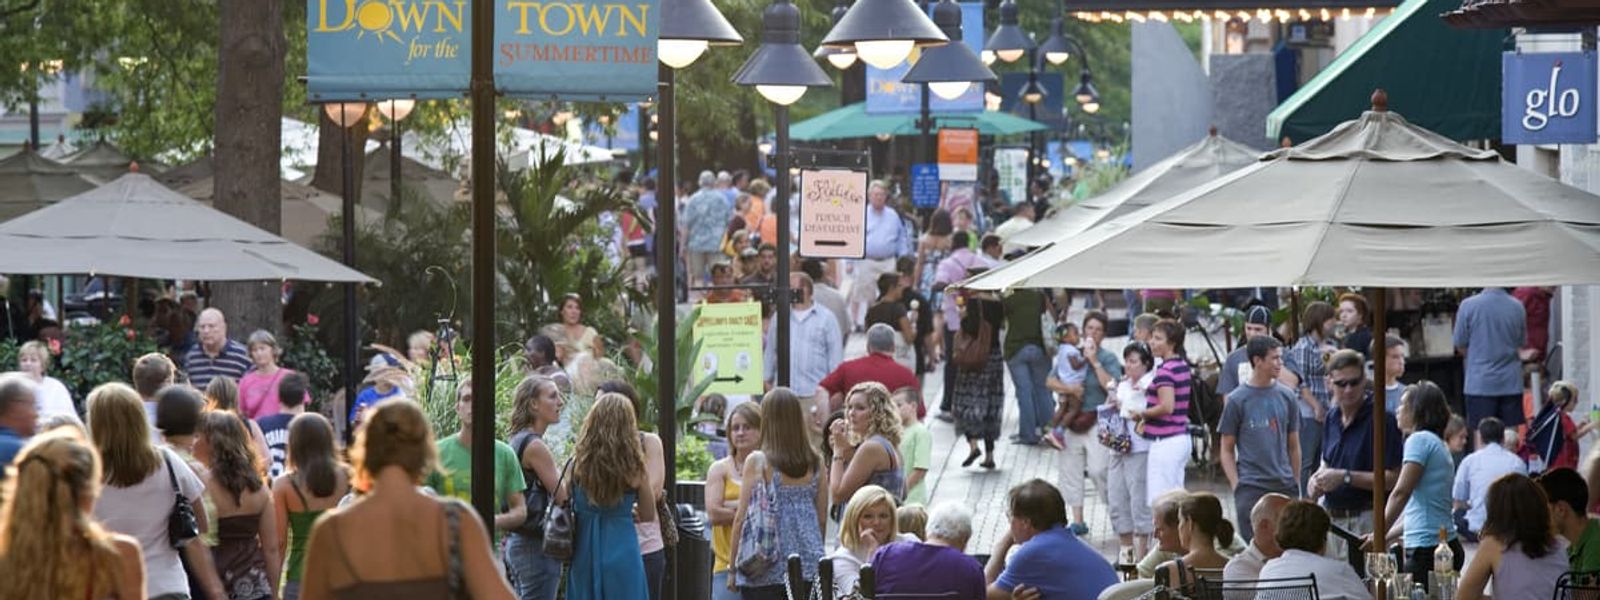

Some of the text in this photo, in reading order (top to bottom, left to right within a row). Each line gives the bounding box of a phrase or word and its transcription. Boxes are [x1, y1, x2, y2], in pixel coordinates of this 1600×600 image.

[508, 1, 648, 37] TOWN
[405, 35, 459, 65] for the
[500, 43, 652, 65] SUMMERTIME
[1522, 67, 1580, 130] glo
